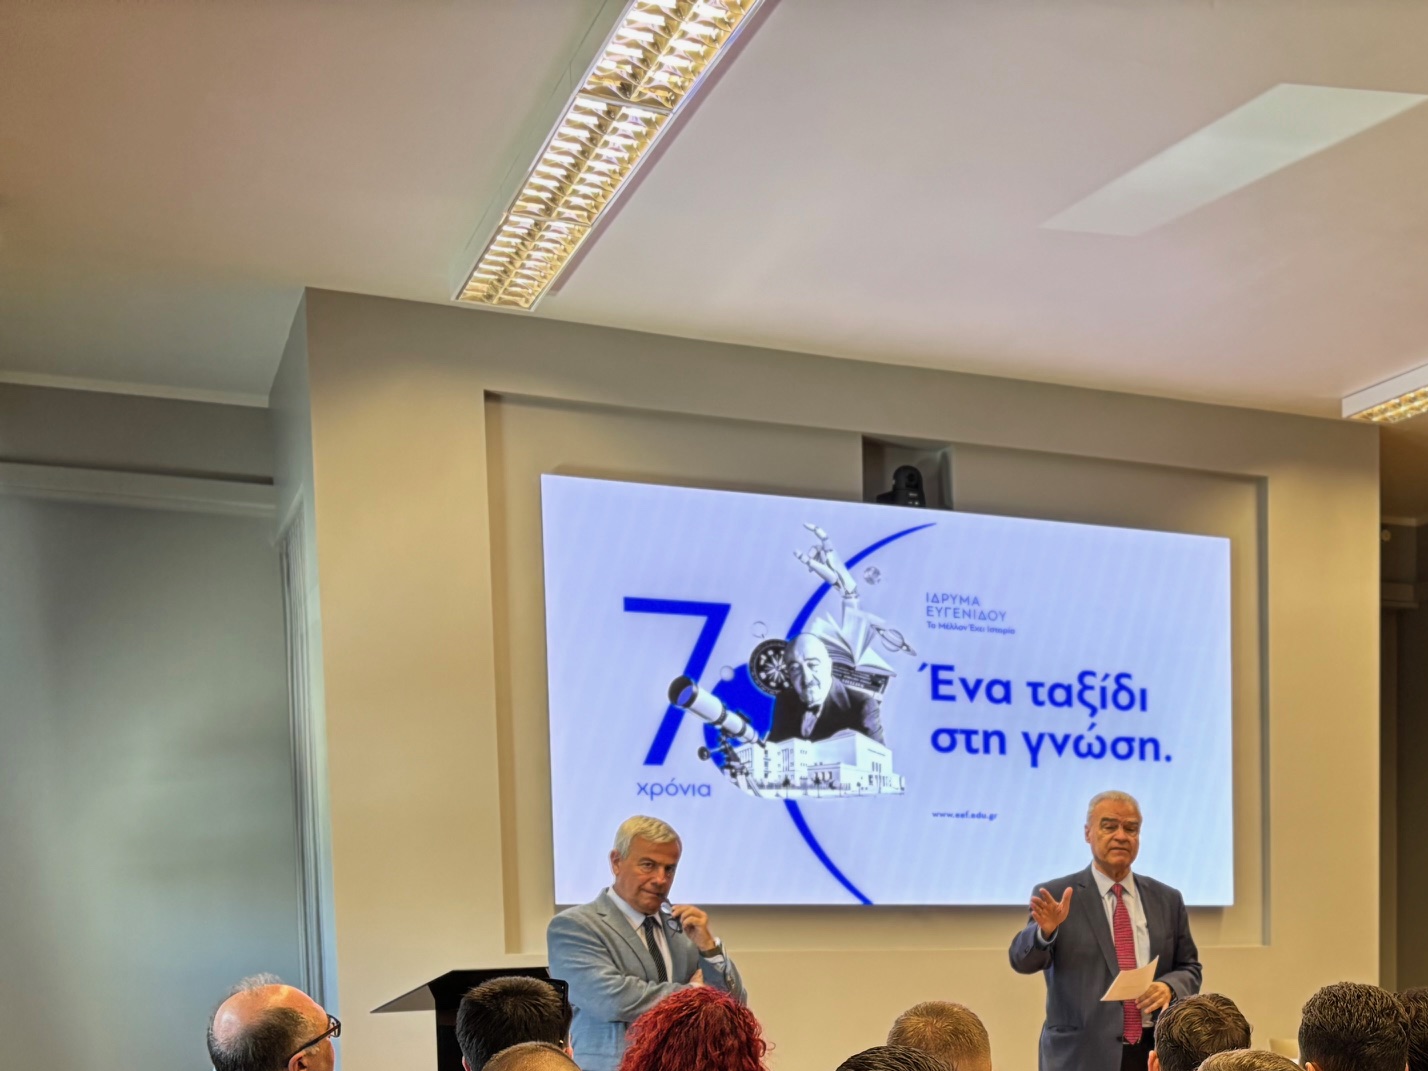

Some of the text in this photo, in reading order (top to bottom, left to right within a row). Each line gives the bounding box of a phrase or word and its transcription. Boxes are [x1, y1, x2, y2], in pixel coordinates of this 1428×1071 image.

[926, 592, 980, 606] ΙΔΡΥΜΑ
[926, 605, 1007, 622] ΕΥΓΕΝΙΔΟΥ
[917, 662, 1147, 719] Ένα ταξίδι
[931, 722, 1172, 768] στη γνώση.
[637, 777, 712, 801] χρόνια
